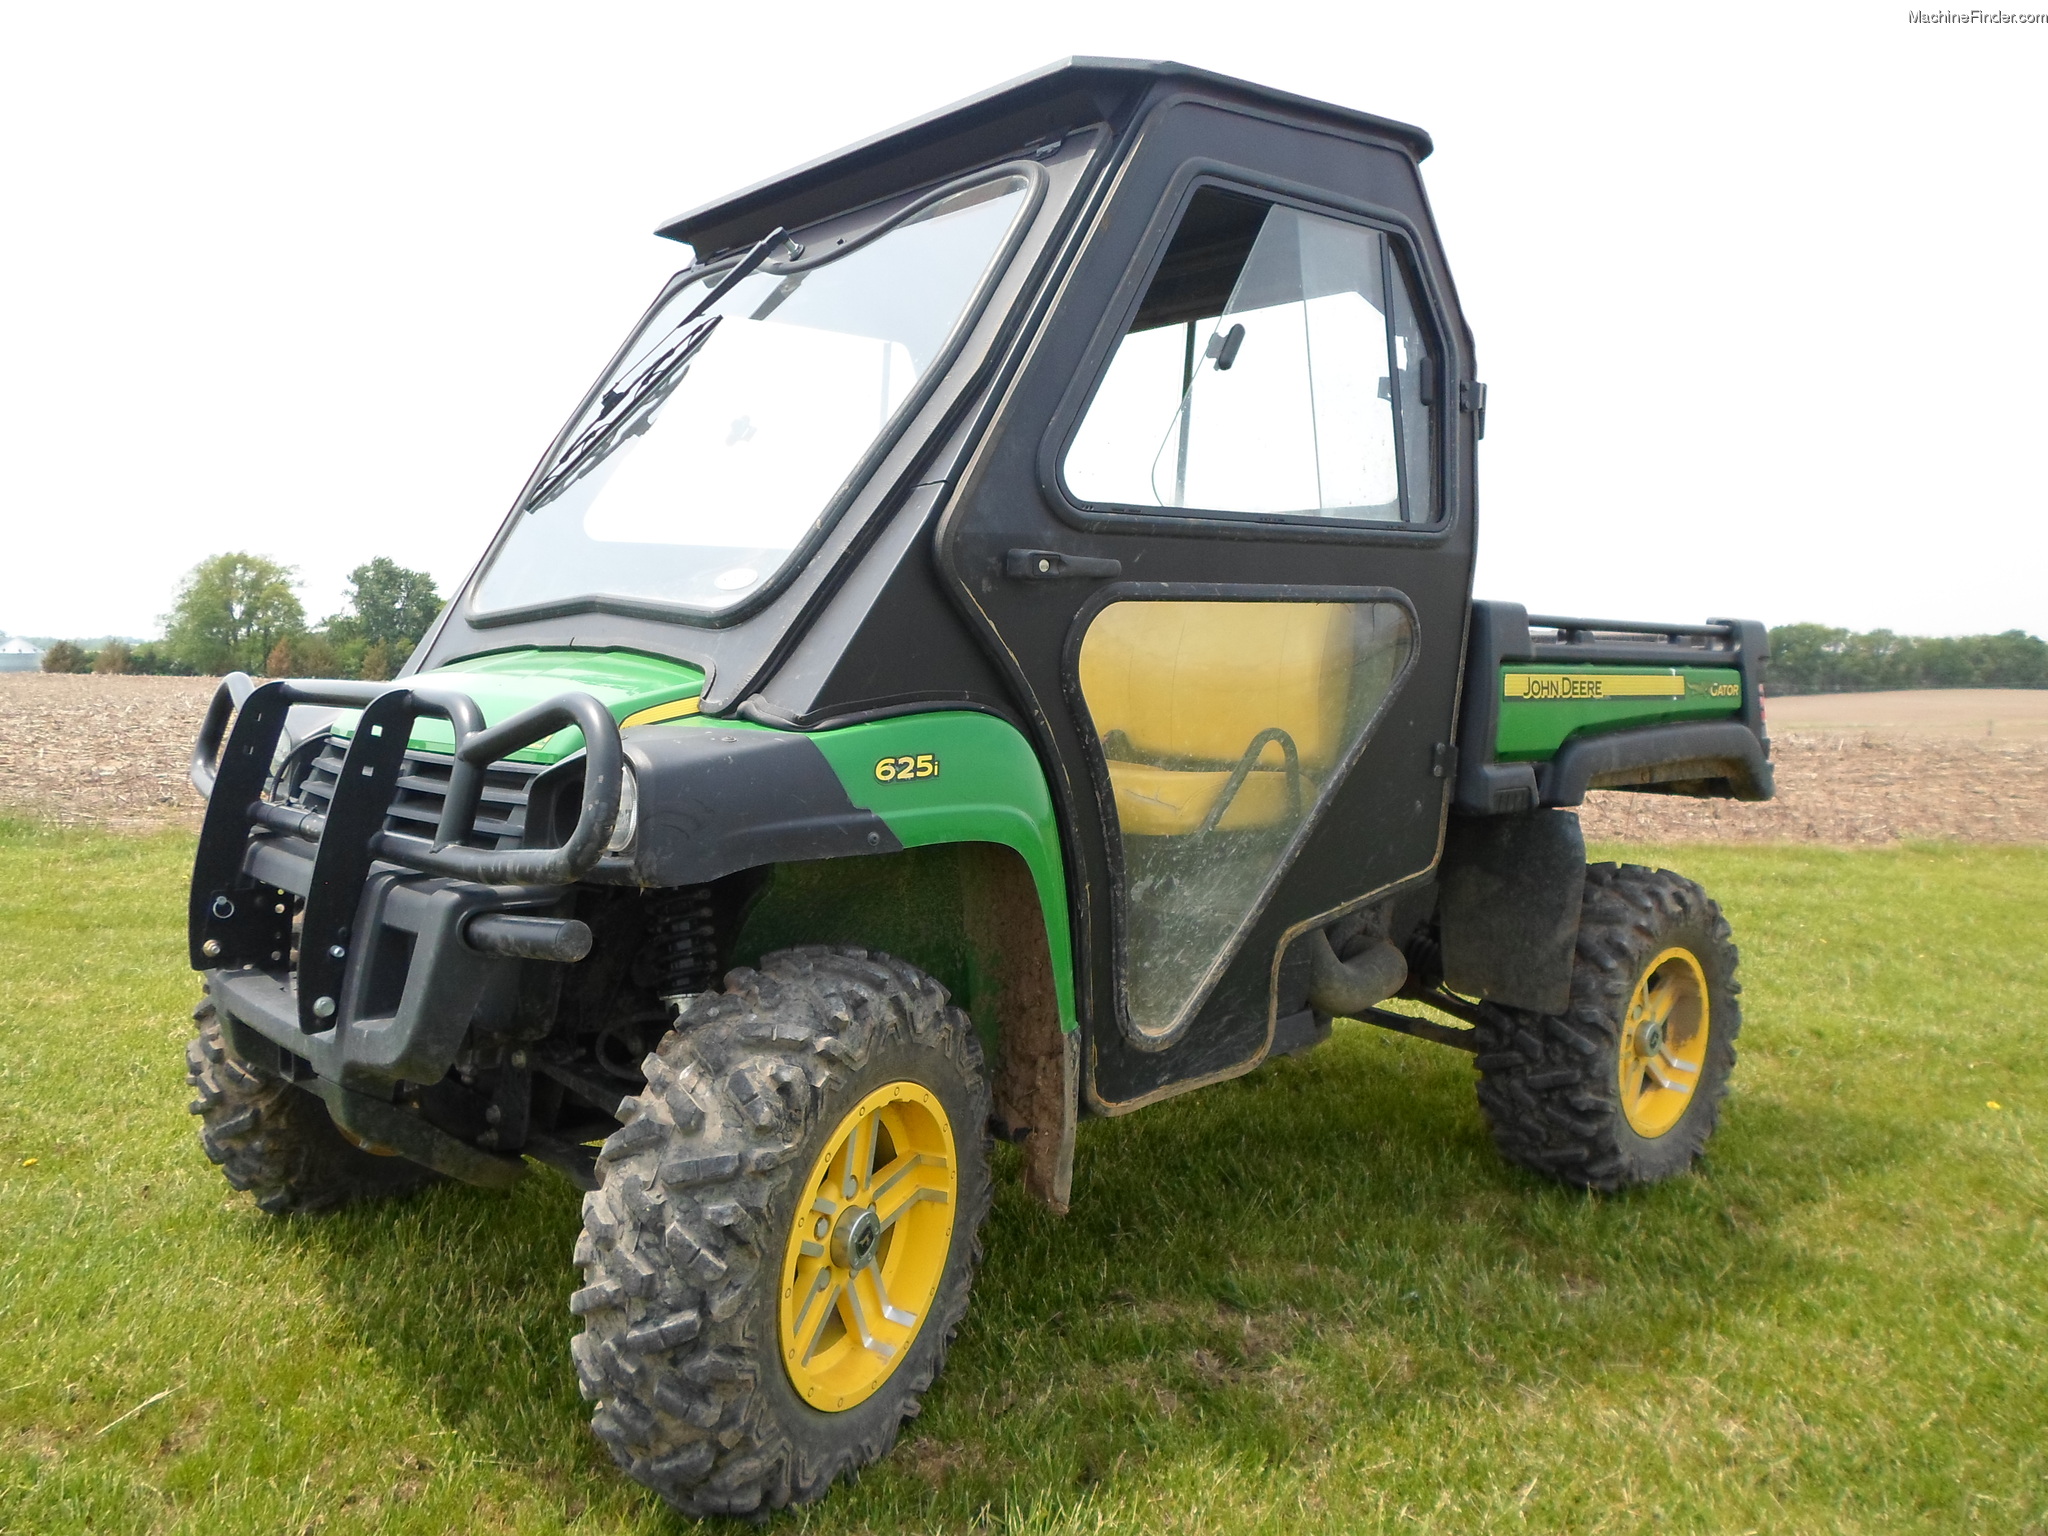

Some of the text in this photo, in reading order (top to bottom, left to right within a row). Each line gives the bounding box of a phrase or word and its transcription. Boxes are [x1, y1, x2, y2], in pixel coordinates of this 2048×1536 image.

[1523, 676, 1603, 697] JOHN DEERE
[1710, 683, 1739, 697] GATOR
[875, 754, 939, 781] 625i
